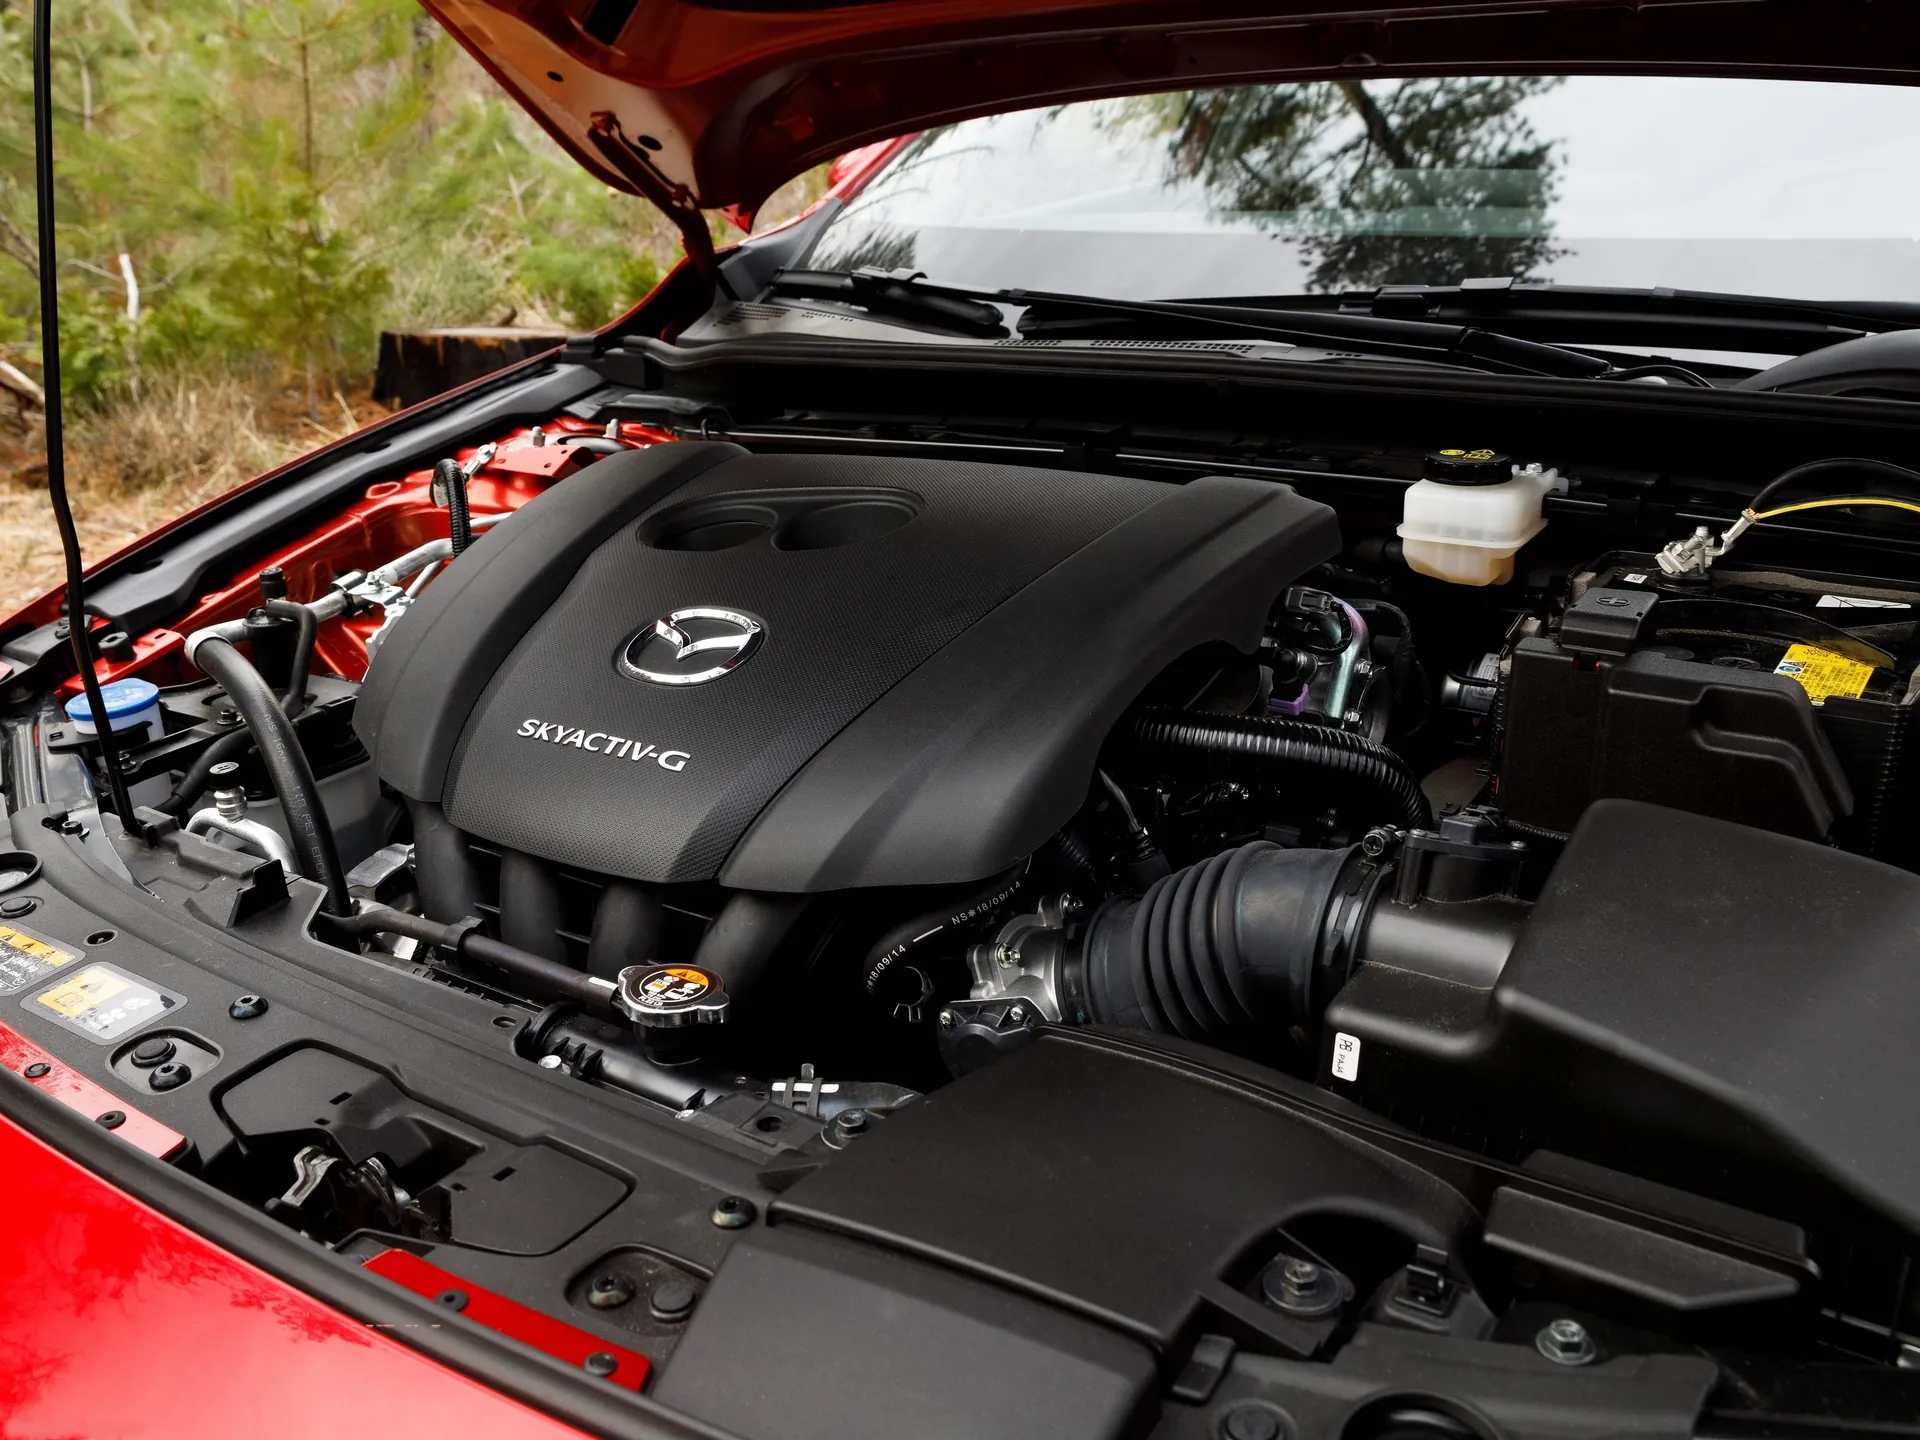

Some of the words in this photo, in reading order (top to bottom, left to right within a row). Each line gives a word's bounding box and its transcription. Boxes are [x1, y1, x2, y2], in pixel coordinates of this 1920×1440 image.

[516, 719, 691, 772] SKYACTIV-G
[301, 813, 317, 838] PET
[311, 846, 327, 880] EPDM
